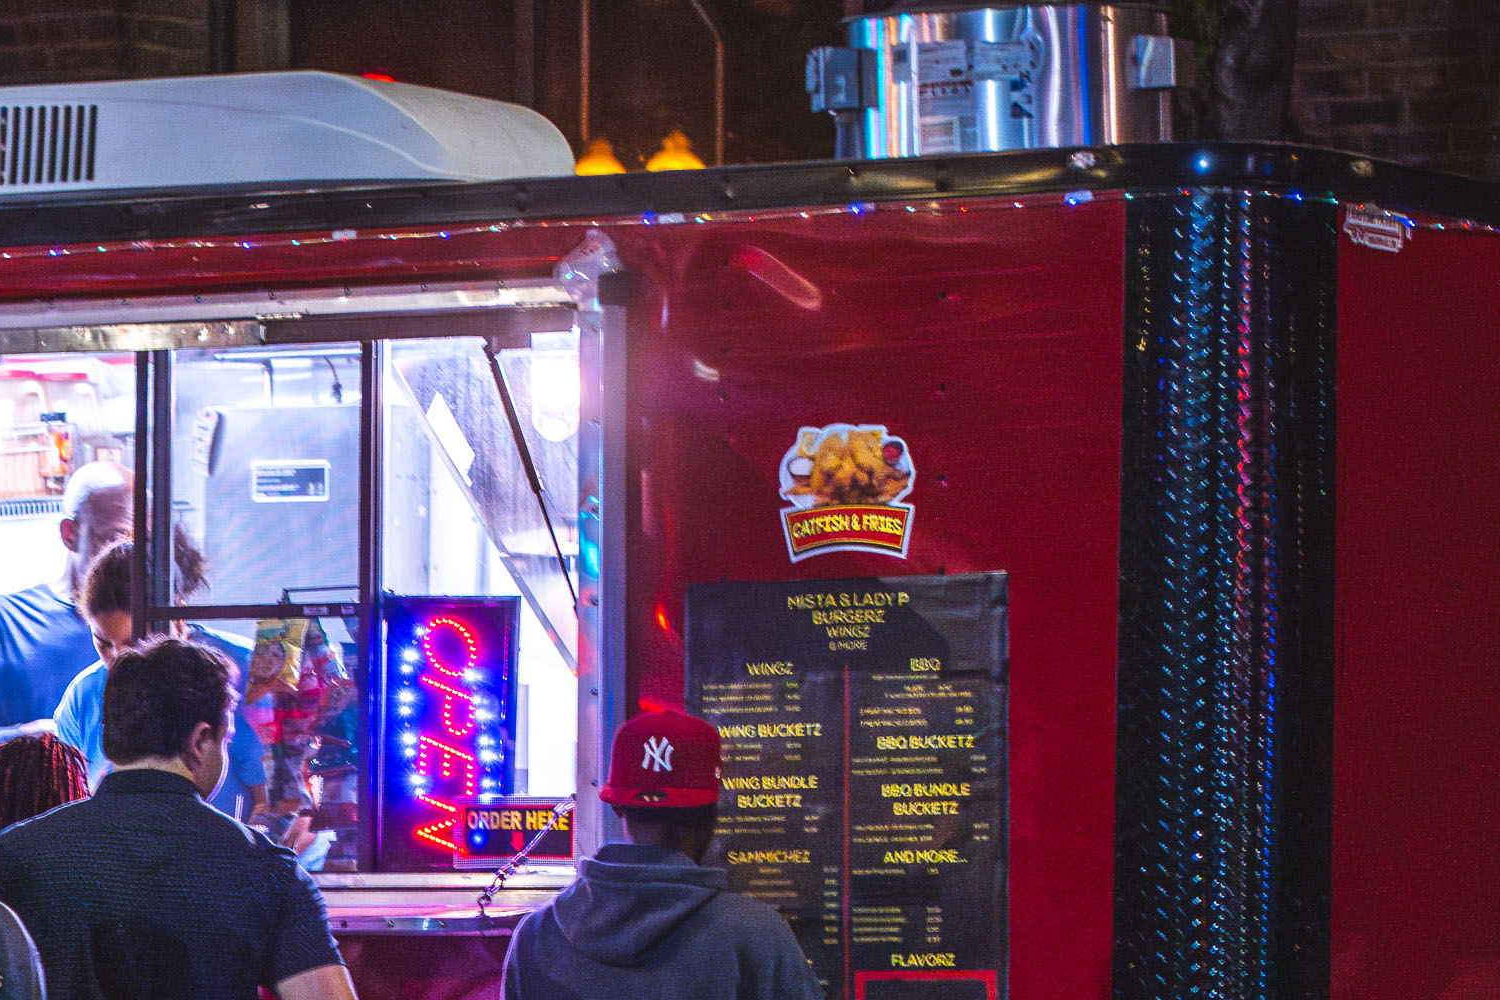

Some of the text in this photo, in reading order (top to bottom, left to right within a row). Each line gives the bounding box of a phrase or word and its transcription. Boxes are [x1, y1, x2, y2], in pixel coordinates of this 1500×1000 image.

[793, 513, 850, 540] CATFISH
[862, 513, 904, 536] FRIES
[786, 593, 838, 610] MISTA
[853, 591, 896, 607] LADY
[897, 591, 910, 607] P
[746, 660, 794, 676] WINGZ
[416, 616, 478, 857] OPEN
[717, 721, 823, 738] WING BUCKETZ
[876, 733, 977, 751] BBQ BUCKETZ
[721, 774, 820, 791] WING BUNDLE
[881, 782, 972, 798] BBQ BUNDLE
[737, 793, 803, 809] BUCKETZ
[893, 801, 960, 816] BUCKETZ
[467, 809, 570, 831] ORDER HERE
[883, 850, 916, 865] AND
[890, 952, 957, 968] FLAVORZ
